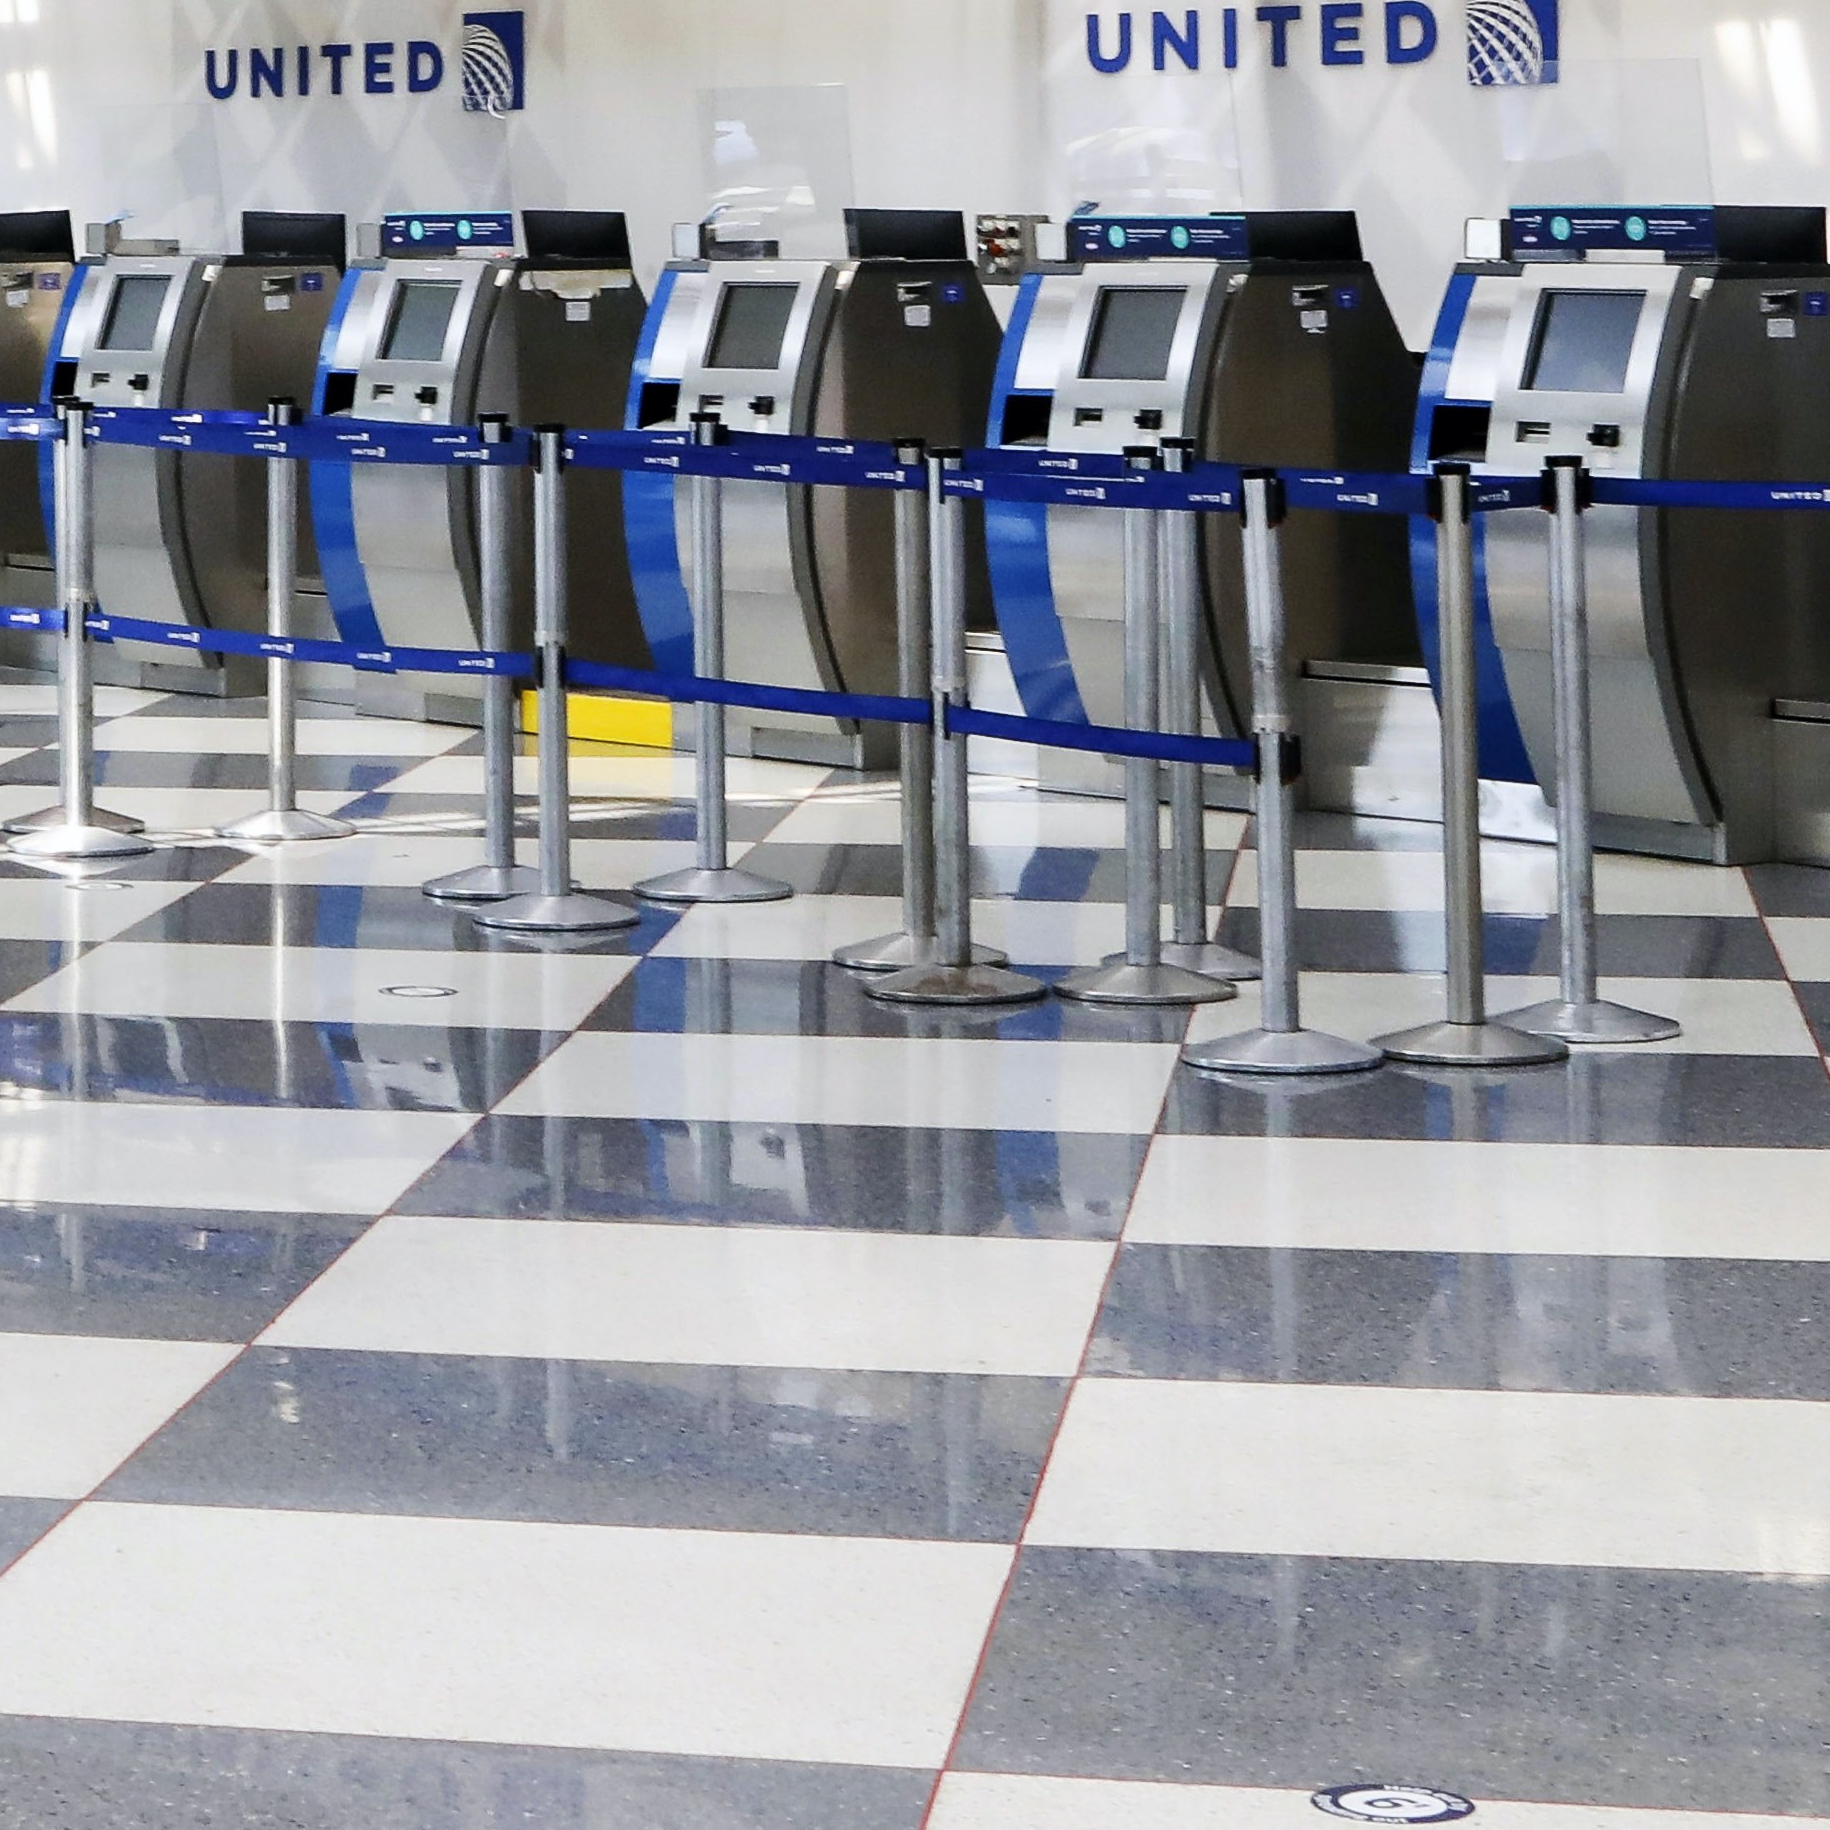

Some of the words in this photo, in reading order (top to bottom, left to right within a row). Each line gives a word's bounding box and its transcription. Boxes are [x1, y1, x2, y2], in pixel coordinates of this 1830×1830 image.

[1087, 0, 1439, 73] UNITED
[205, 40, 445, 100] UNITED
[1771, 490, 1823, 500] UNITED
